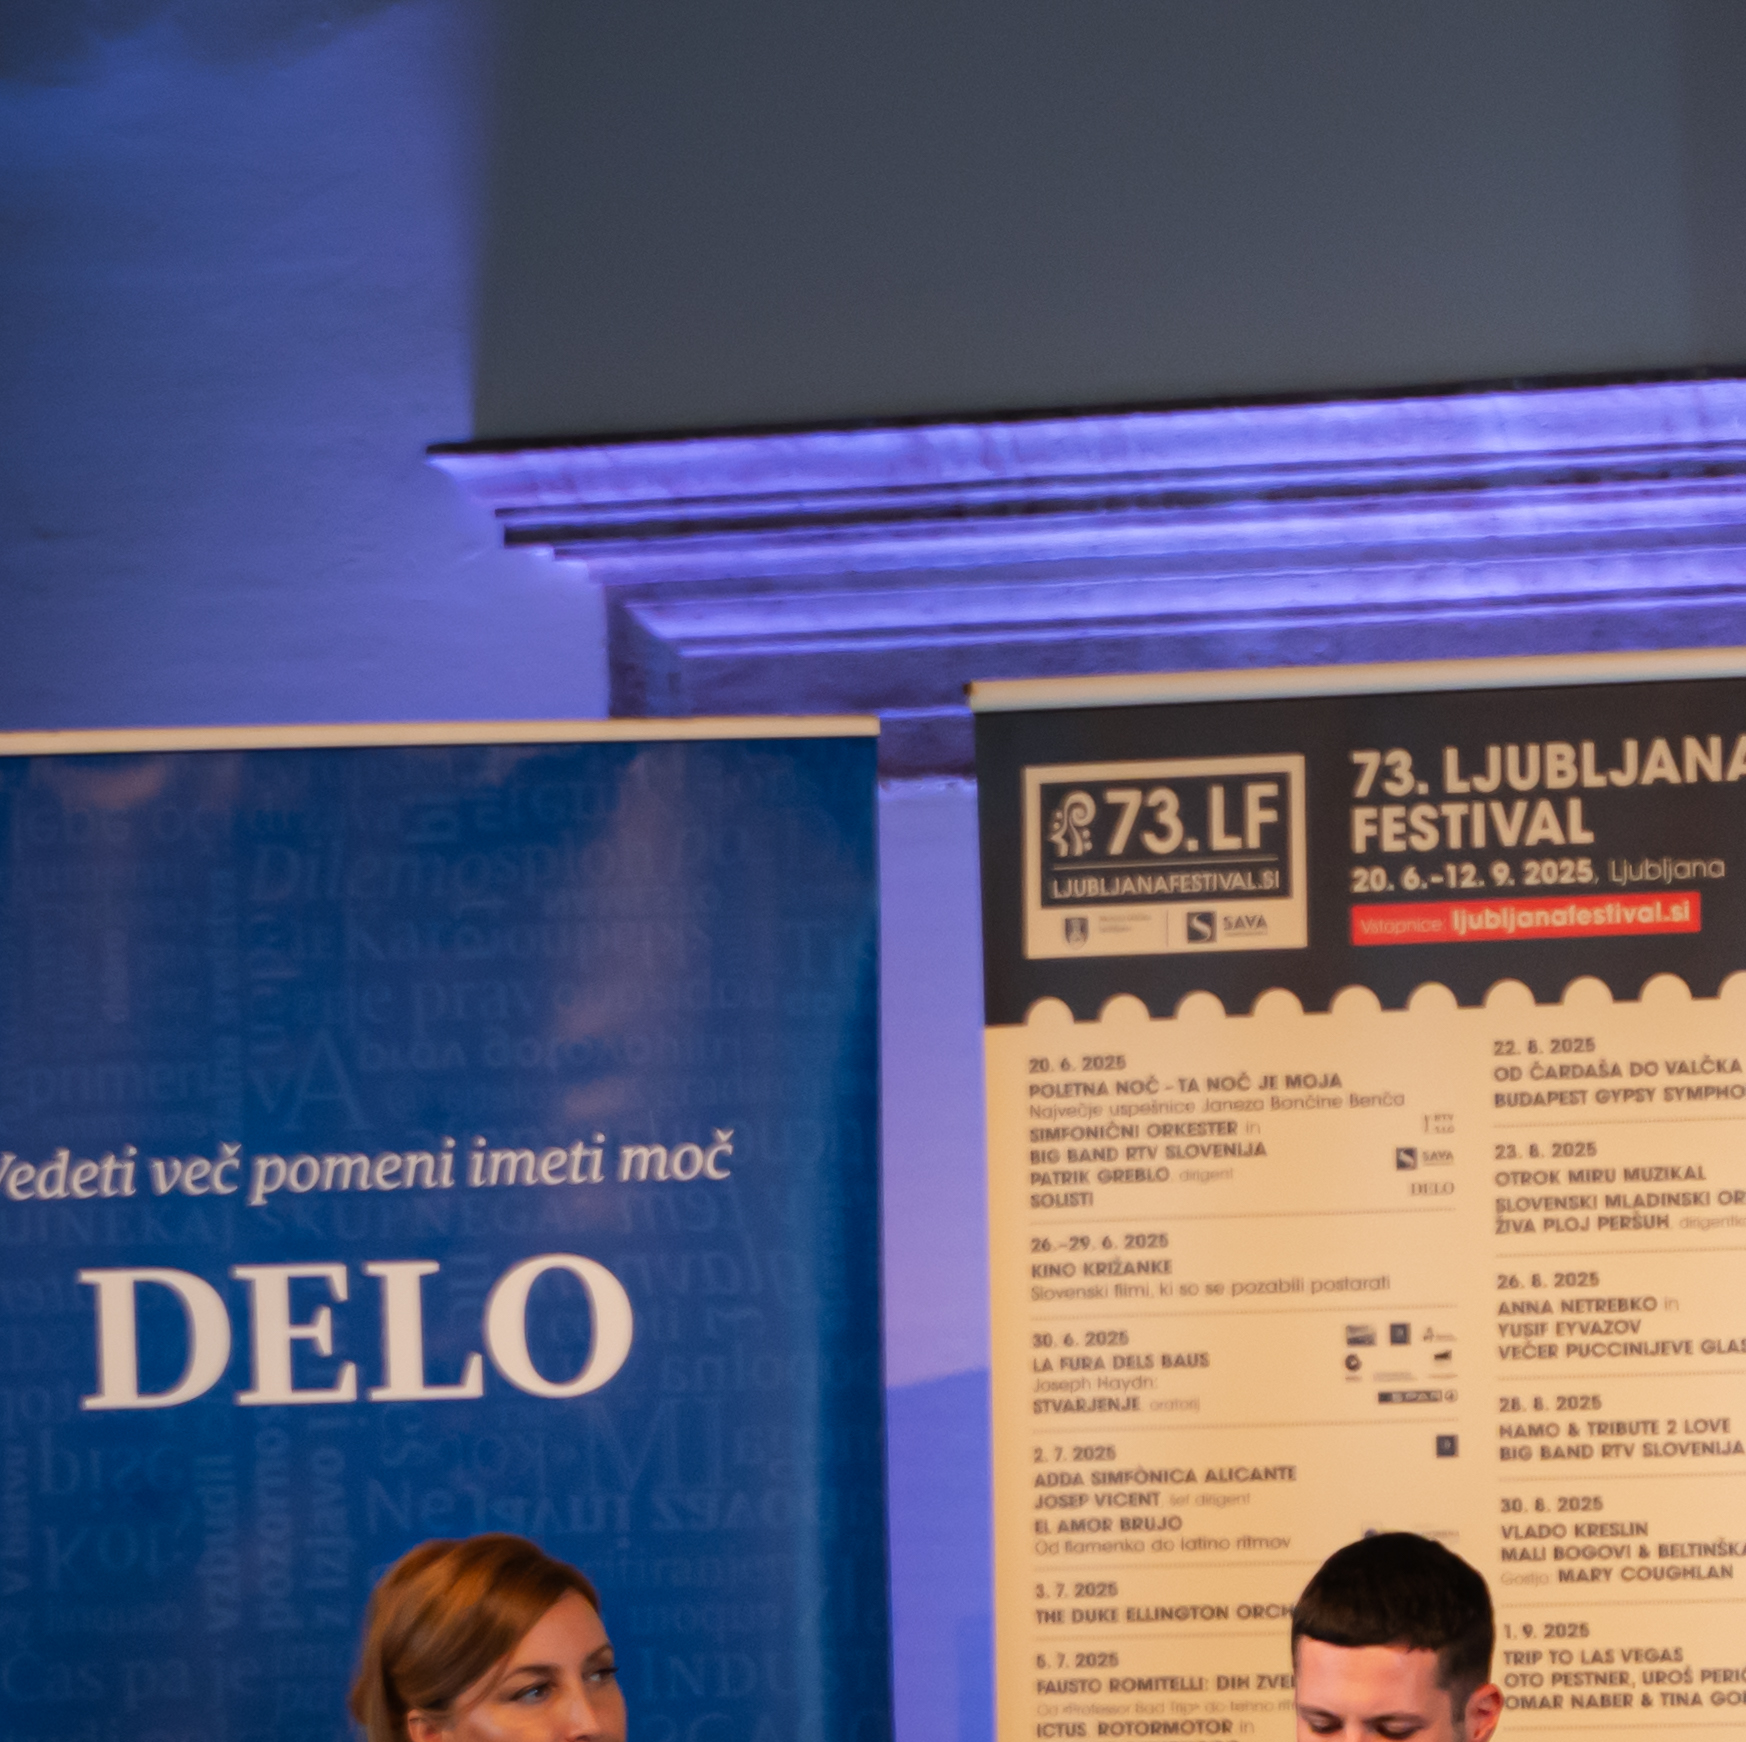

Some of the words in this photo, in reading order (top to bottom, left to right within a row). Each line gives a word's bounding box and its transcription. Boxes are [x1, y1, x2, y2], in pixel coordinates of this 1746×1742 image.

[1351, 748, 1428, 798] 73.
[1352, 797, 1594, 853] FESTIVAL
[1052, 870, 1279, 899] LJUBLJANAFESTIVAL.SI
[1352, 866, 1394, 892] 20.
[1490, 860, 1515, 886] 9.
[1609, 858, 1725, 885] Ljubljana
[1452, 900, 1690, 936] ljubljanafestival.si
[1495, 1089, 1588, 1108] BUDAPEST
[1595, 1086, 1656, 1105] GYPSY
[152, 1143, 241, 1195] več
[249, 1138, 456, 1205] pomeni
[470, 1134, 605, 1187] imeti
[622, 1129, 734, 1181] moč
[1495, 1170, 1561, 1187] OTROK
[1568, 1168, 1617, 1185] MIRU
[1624, 1165, 1706, 1183] MUZIKAL
[1495, 1194, 1598, 1213] SLOVENSKI
[1605, 1191, 1711, 1210] MLADINSKI
[1031, 1262, 1076, 1278] KINO
[1083, 1260, 1173, 1277] KRIŽANKE
[79, 1253, 634, 1411] DELO
[1500, 1338, 1558, 1360] VEČER
[1566, 1339, 1693, 1358] PUCCINIJEVE
[1500, 1445, 1533, 1461] BIG
[1540, 1444, 1594, 1460] BAND
[1601, 1442, 1634, 1459] RTV
[1642, 1439, 1745, 1457] SLOVENIJA
[1502, 1523, 1567, 1540] VLADO
[1574, 1521, 1648, 1538] KRESLIN
[1502, 1546, 1546, 1563] MALI
[1554, 1544, 1631, 1562] BOGOVI
[1504, 1650, 1543, 1665] TRIP
[1549, 1648, 1573, 1665] TO
[1581, 1648, 1614, 1664] LAS
[1621, 1646, 1683, 1664] VEGAS
[1504, 1693, 1564, 1711] OMAR
[1571, 1691, 1633, 1708] NABER
[1660, 1690, 1703, 1707] TINA
